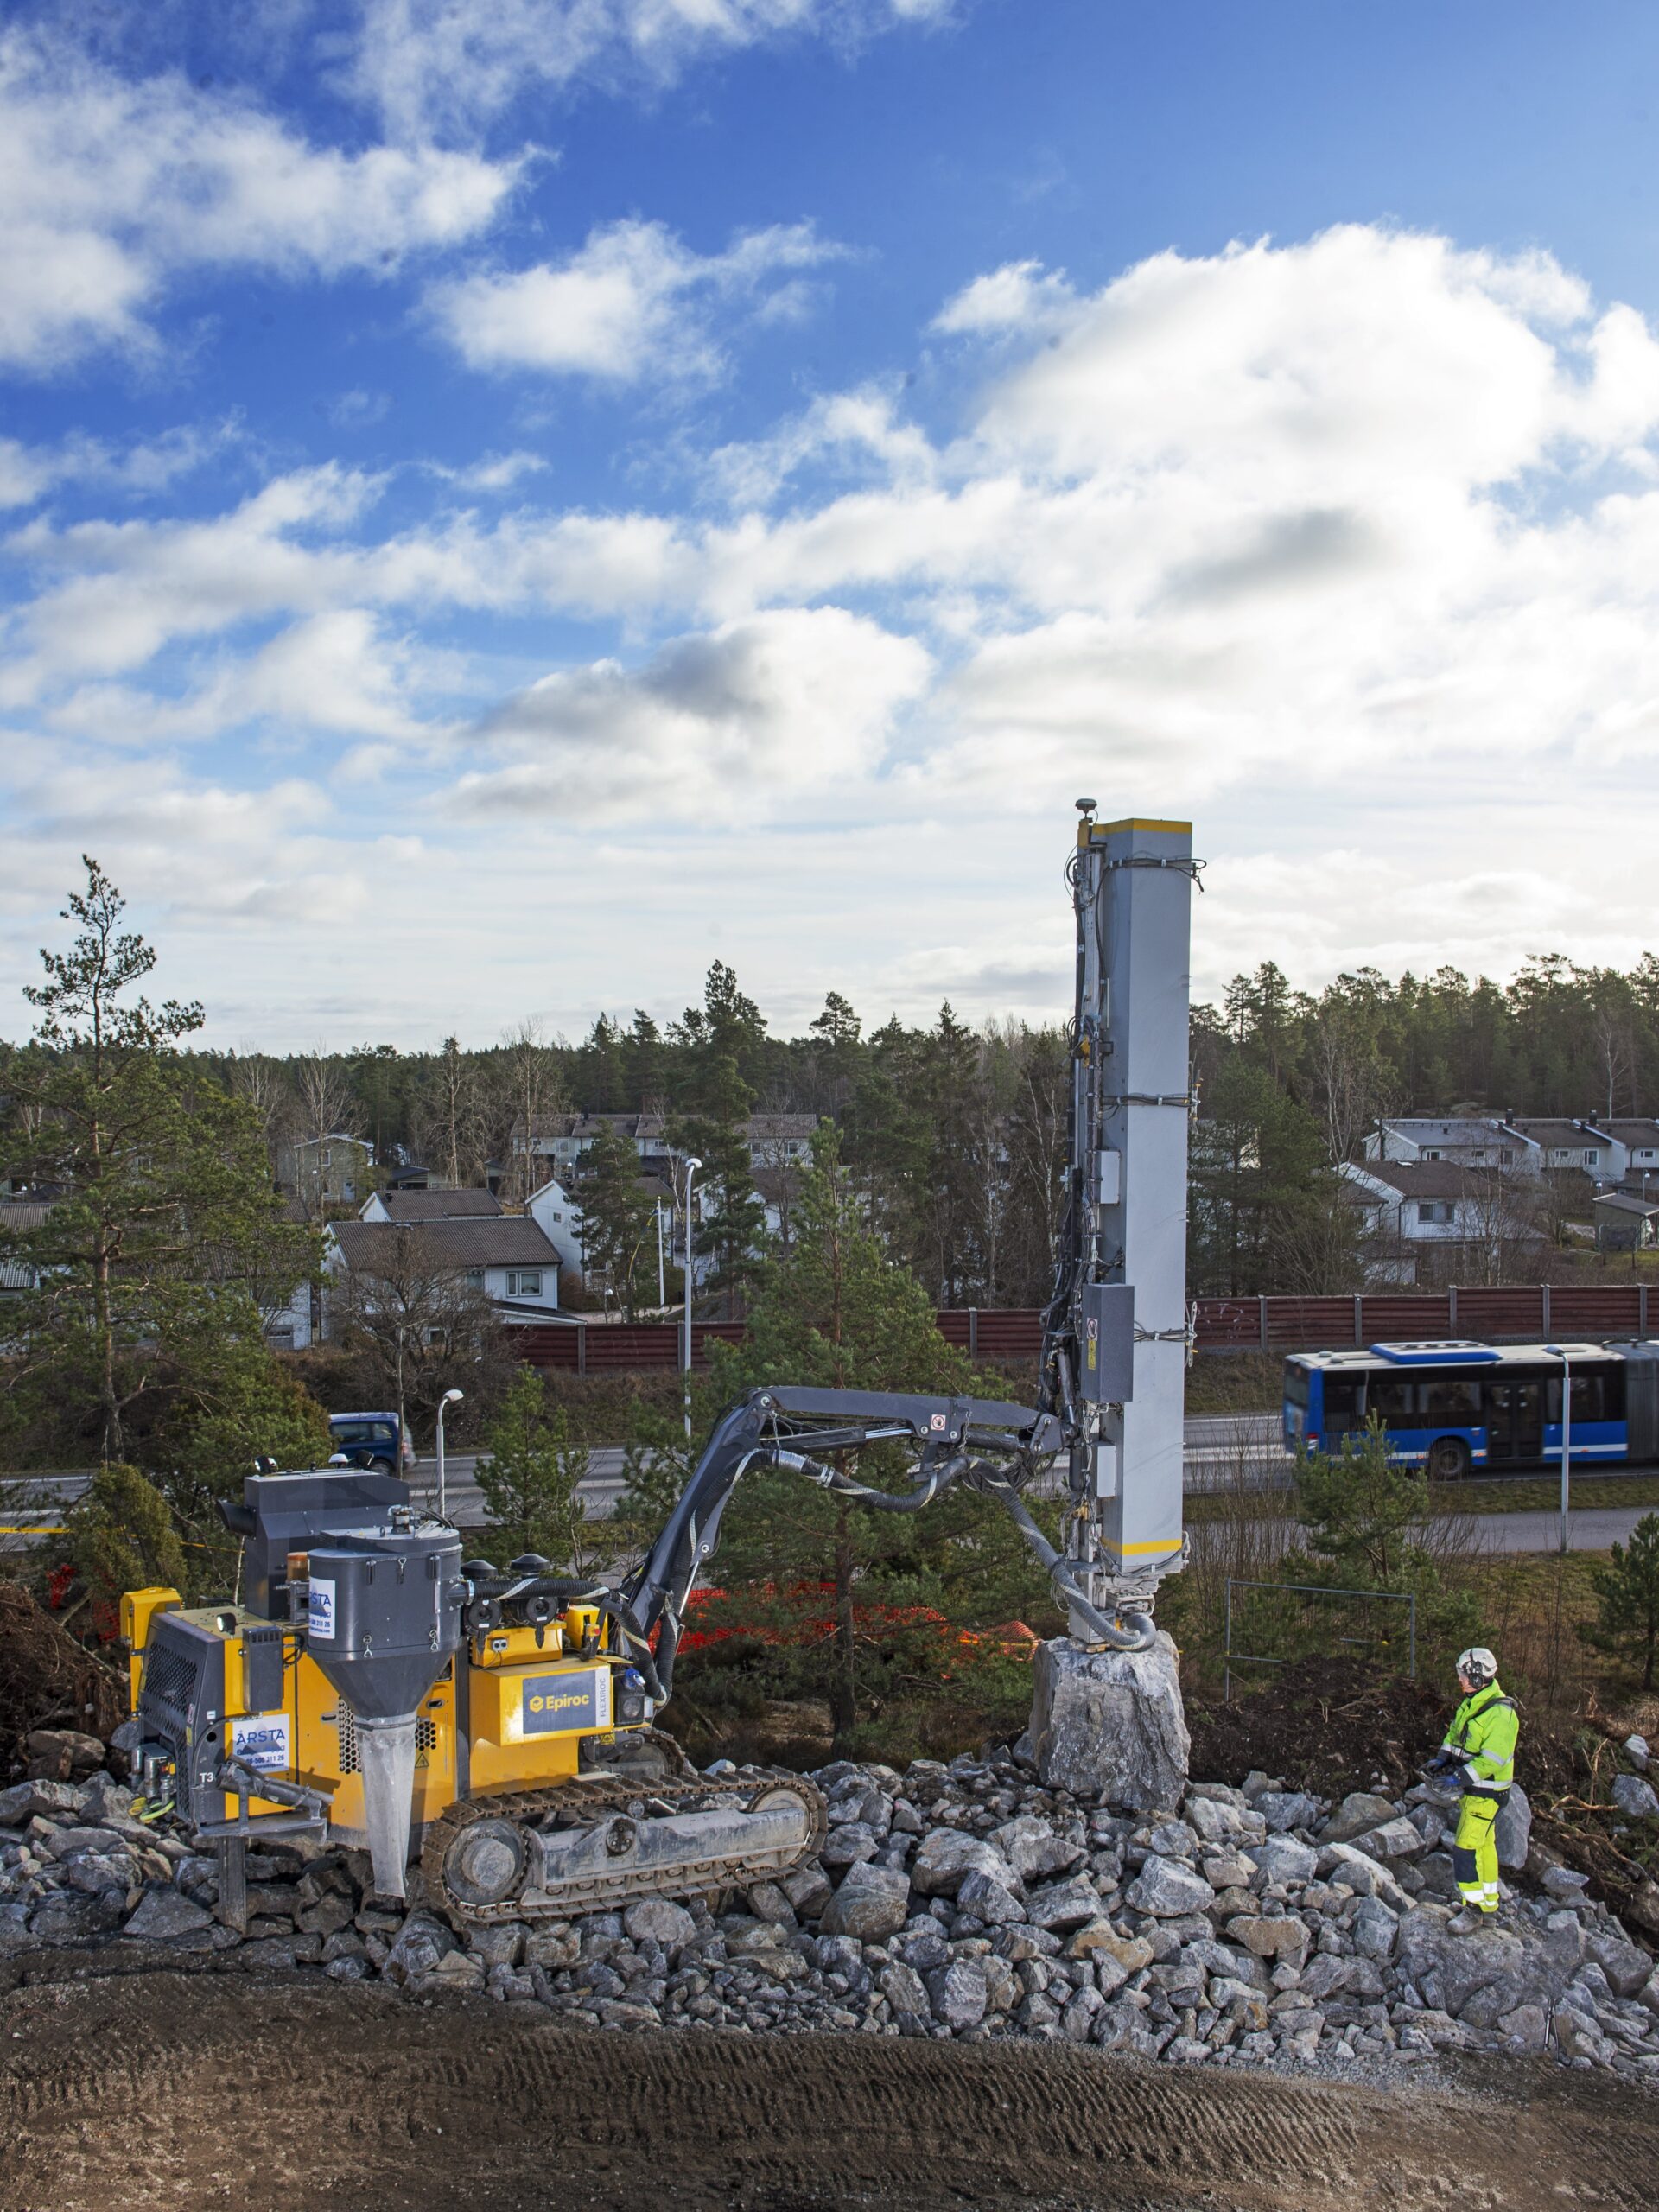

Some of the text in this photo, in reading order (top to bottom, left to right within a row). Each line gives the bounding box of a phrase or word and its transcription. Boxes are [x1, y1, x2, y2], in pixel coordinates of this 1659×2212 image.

[546, 1694, 589, 1712] Epiroc
[237, 1729, 284, 1745] ÅRSTA
[200, 1772, 213, 1783] T3
